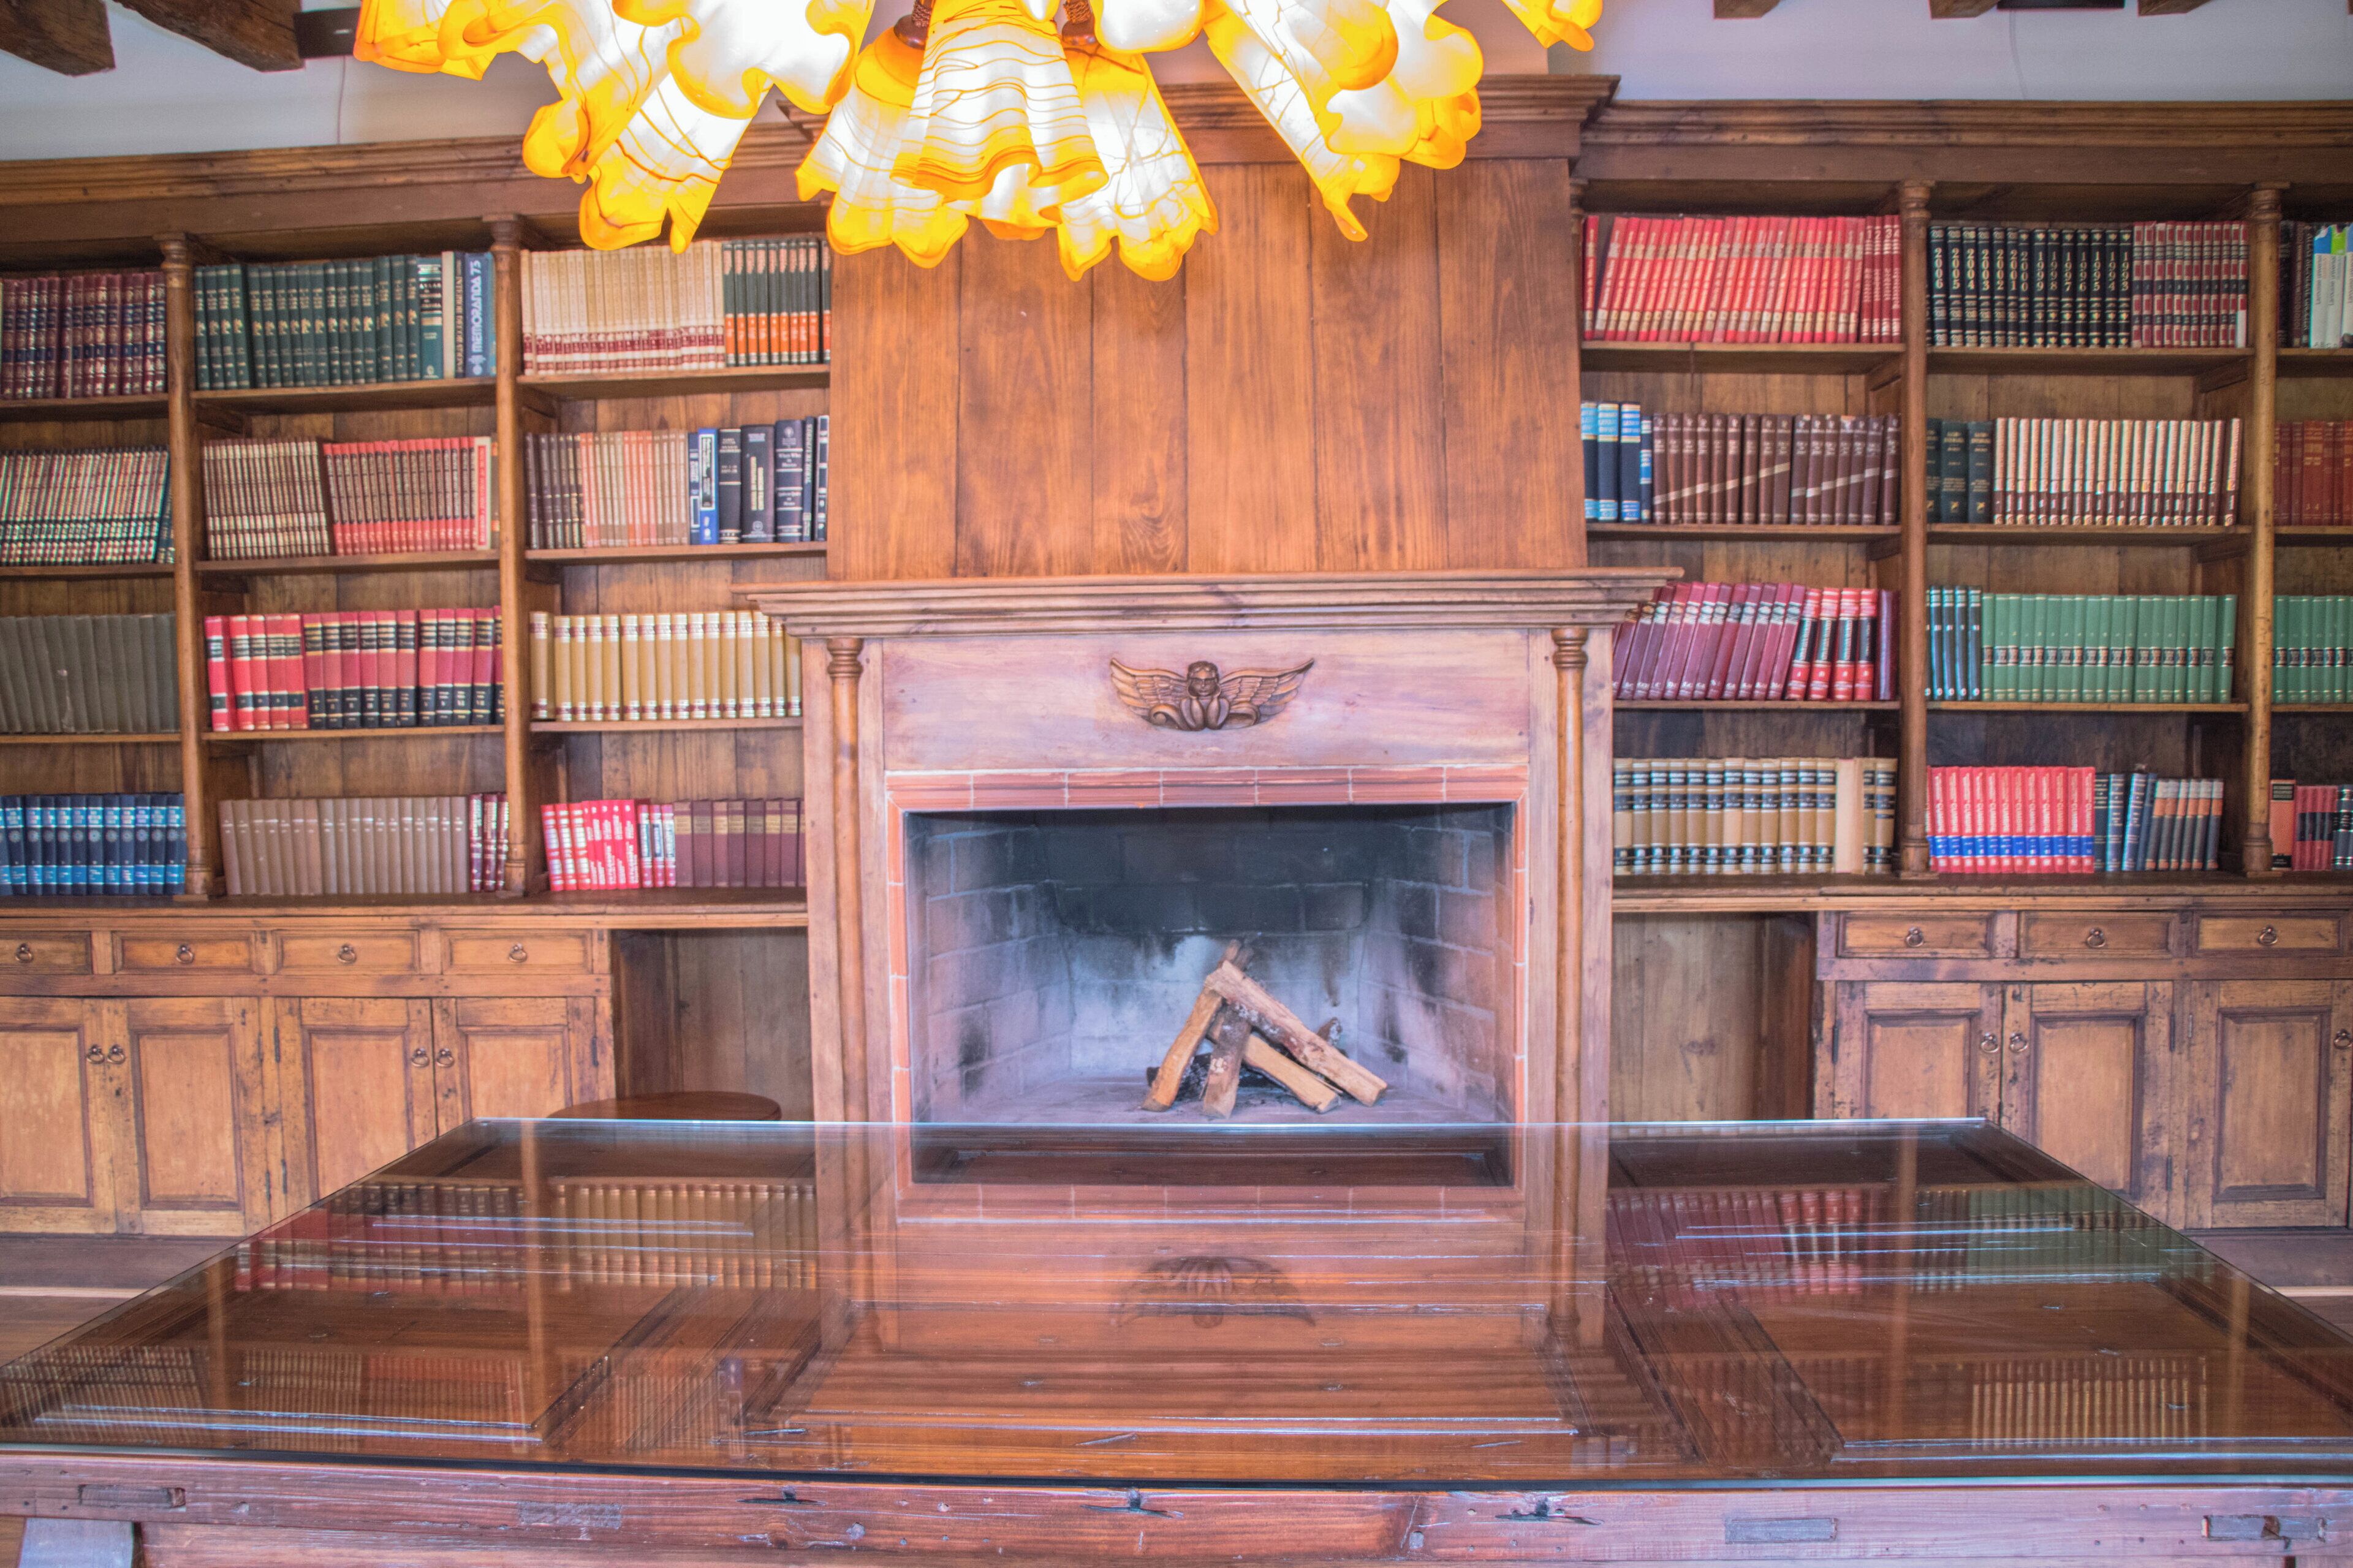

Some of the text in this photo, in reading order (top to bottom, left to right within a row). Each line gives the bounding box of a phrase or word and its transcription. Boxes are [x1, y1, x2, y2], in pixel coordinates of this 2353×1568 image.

[1934, 248, 1944, 289] 2006
[1952, 248, 1960, 290] 2005
[1966, 248, 1975, 290] 2004
[1981, 248, 1990, 290] 2003
[1996, 248, 2005, 290] 2002
[2020, 251, 2029, 292] 2000
[2036, 251, 2045, 292] 1999
[2064, 251, 2073, 292] 1997
[2079, 251, 2088, 292] 1996
[471, 276, 483, 354] MEMORANDA
